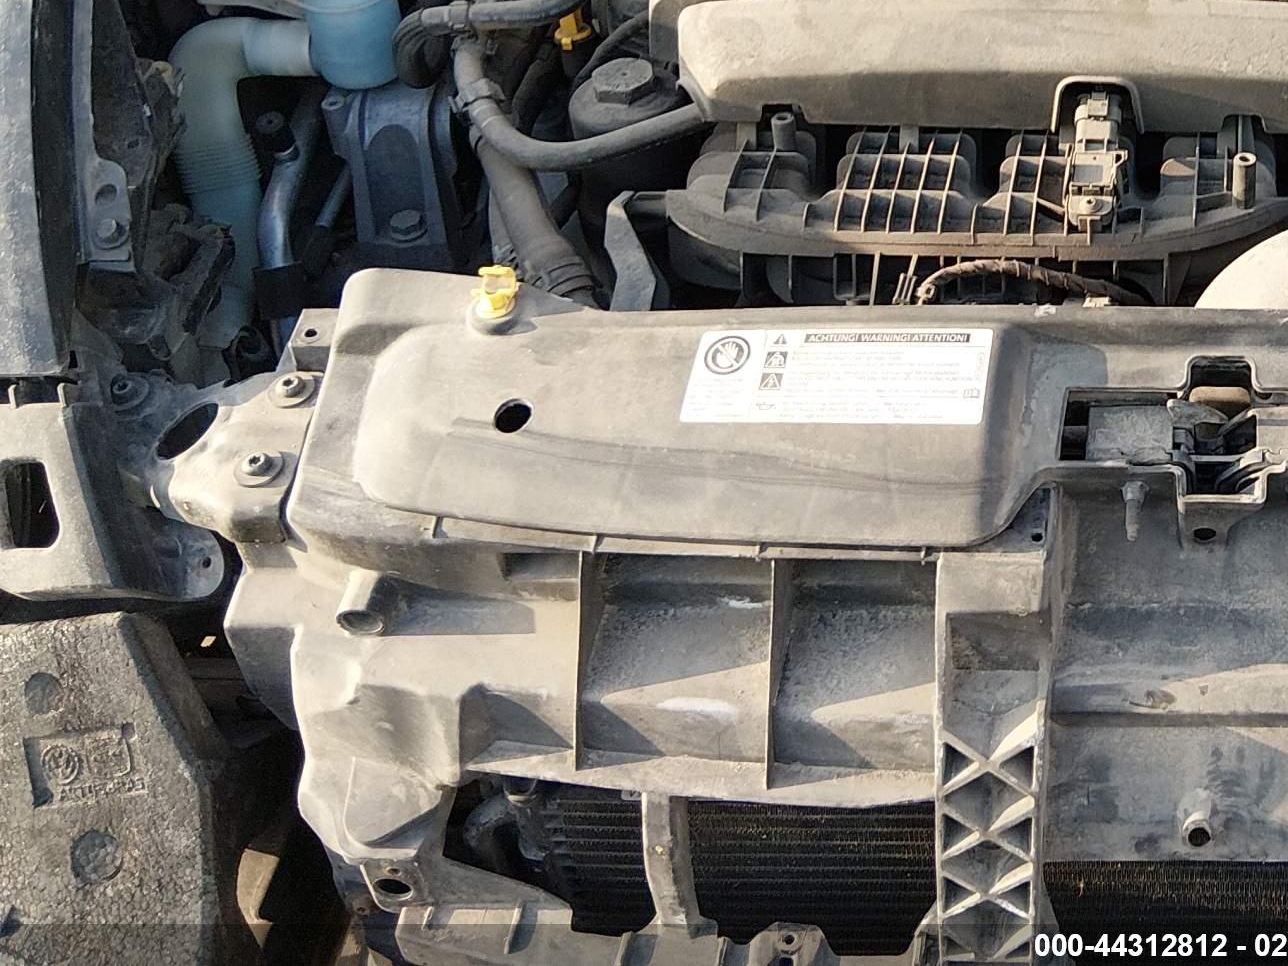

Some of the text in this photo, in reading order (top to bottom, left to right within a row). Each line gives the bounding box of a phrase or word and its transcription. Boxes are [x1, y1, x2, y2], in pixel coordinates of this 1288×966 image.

[808, 333, 968, 343] ACHTUNG! WARNING! ATTENTION!
